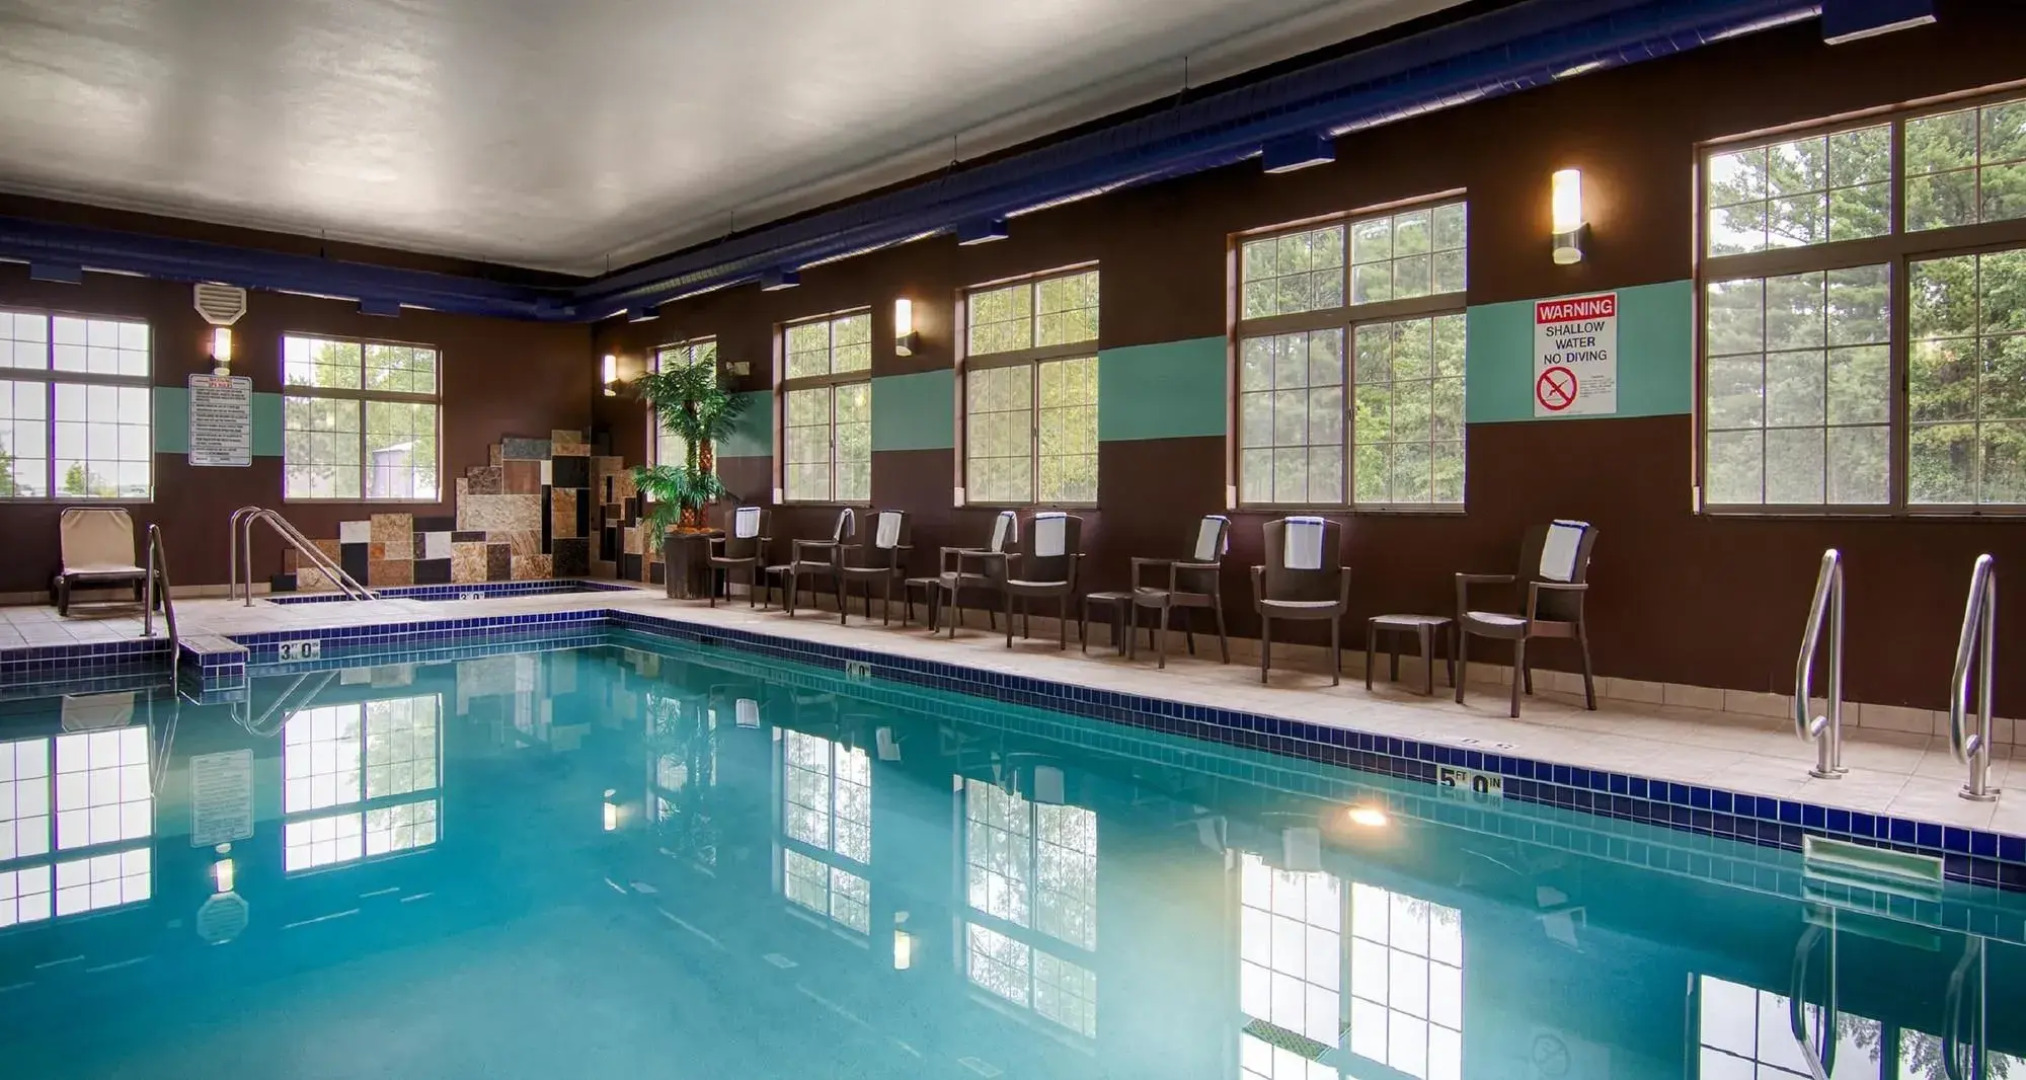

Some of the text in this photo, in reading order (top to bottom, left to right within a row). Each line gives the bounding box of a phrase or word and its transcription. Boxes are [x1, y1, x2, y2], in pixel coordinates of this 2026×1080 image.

[1540, 300, 1612, 320] WARNING
[1546, 321, 1605, 337] SHALLOW
[1555, 337, 1596, 350] WATER
[1544, 350, 1607, 365] NO DIVING
[281, 644, 291, 660] 3
[301, 643, 312, 658] 0
[858, 665, 865, 676] 0
[1441, 768, 1501, 793] 5 FT 0 IN
